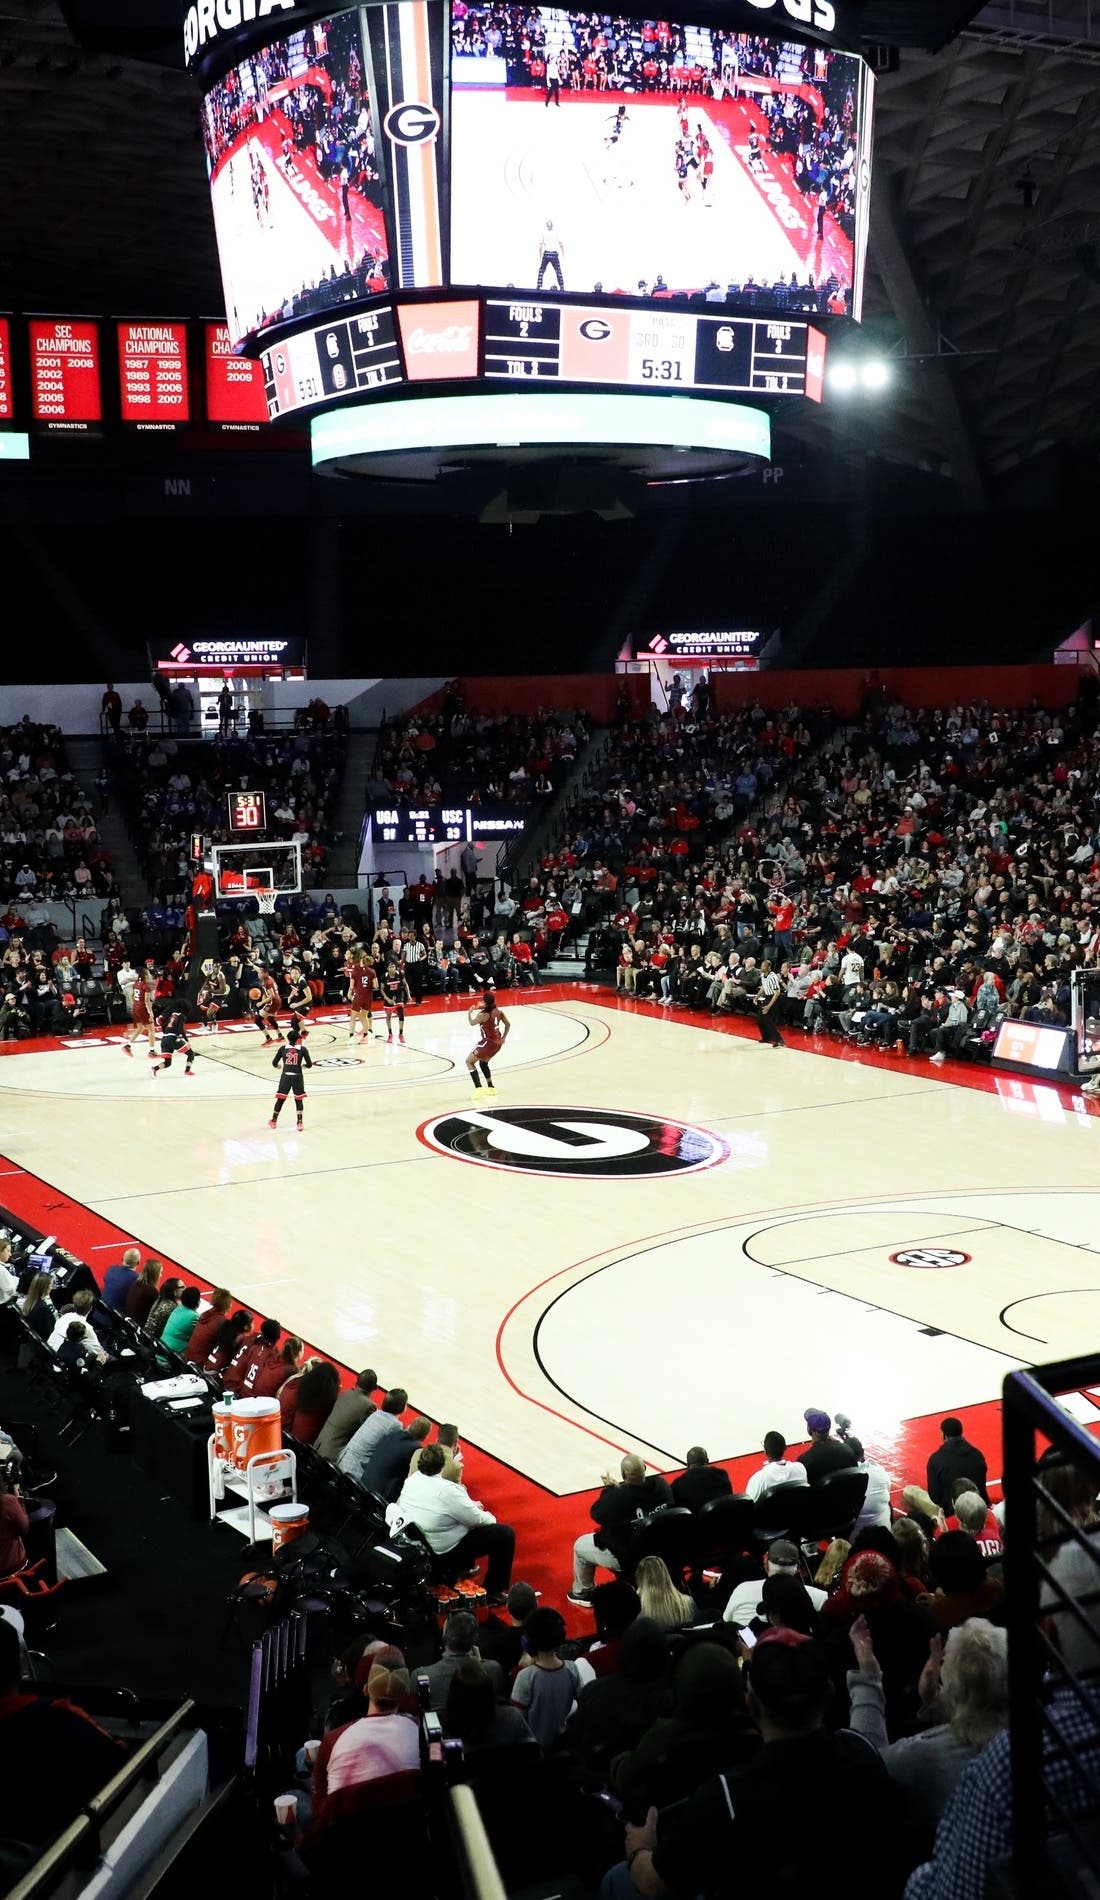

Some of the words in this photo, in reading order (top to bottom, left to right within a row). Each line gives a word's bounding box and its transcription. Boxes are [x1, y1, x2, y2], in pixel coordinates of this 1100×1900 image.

[509, 306, 543, 323] FOULS
[55, 325, 72, 338] SEC
[129, 328, 174, 340] NATIONAL
[520, 322, 529, 337] 2
[767, 325, 791, 340] FOULS
[36, 338, 91, 352] CHAMPIONS
[125, 341, 179, 354] CHAMPIONS
[36, 358, 61, 367] 2001
[67, 359, 94, 368] 2008
[125, 360, 149, 369] 1987
[157, 360, 181, 369] 1999
[226, 361, 252, 370] 2008
[37, 369, 63, 379] 2002
[641, 359, 683, 381] 5:31
[125, 371, 150, 380] 1989
[156, 372, 182, 381] 2005
[226, 373, 253, 382] 2009
[37, 381, 64, 390] 2004
[126, 383, 150, 392] 1993
[156, 384, 182, 393] 2006
[38, 393, 64, 402] 2005
[127, 394, 151, 404] 1998
[157, 395, 183, 404] 2007
[38, 405, 65, 414] 2006
[763, 467, 784, 484] PP
[165, 480, 190, 495] NN
[238, 796, 260, 806] 5:31
[236, 807, 258, 826] 30
[442, 810, 463, 823] USC
[473, 820, 524, 830] NISSAN
[361, 976, 368, 984] 12
[285, 1053, 298, 1065] 21
[234, 1425, 245, 1441] G
